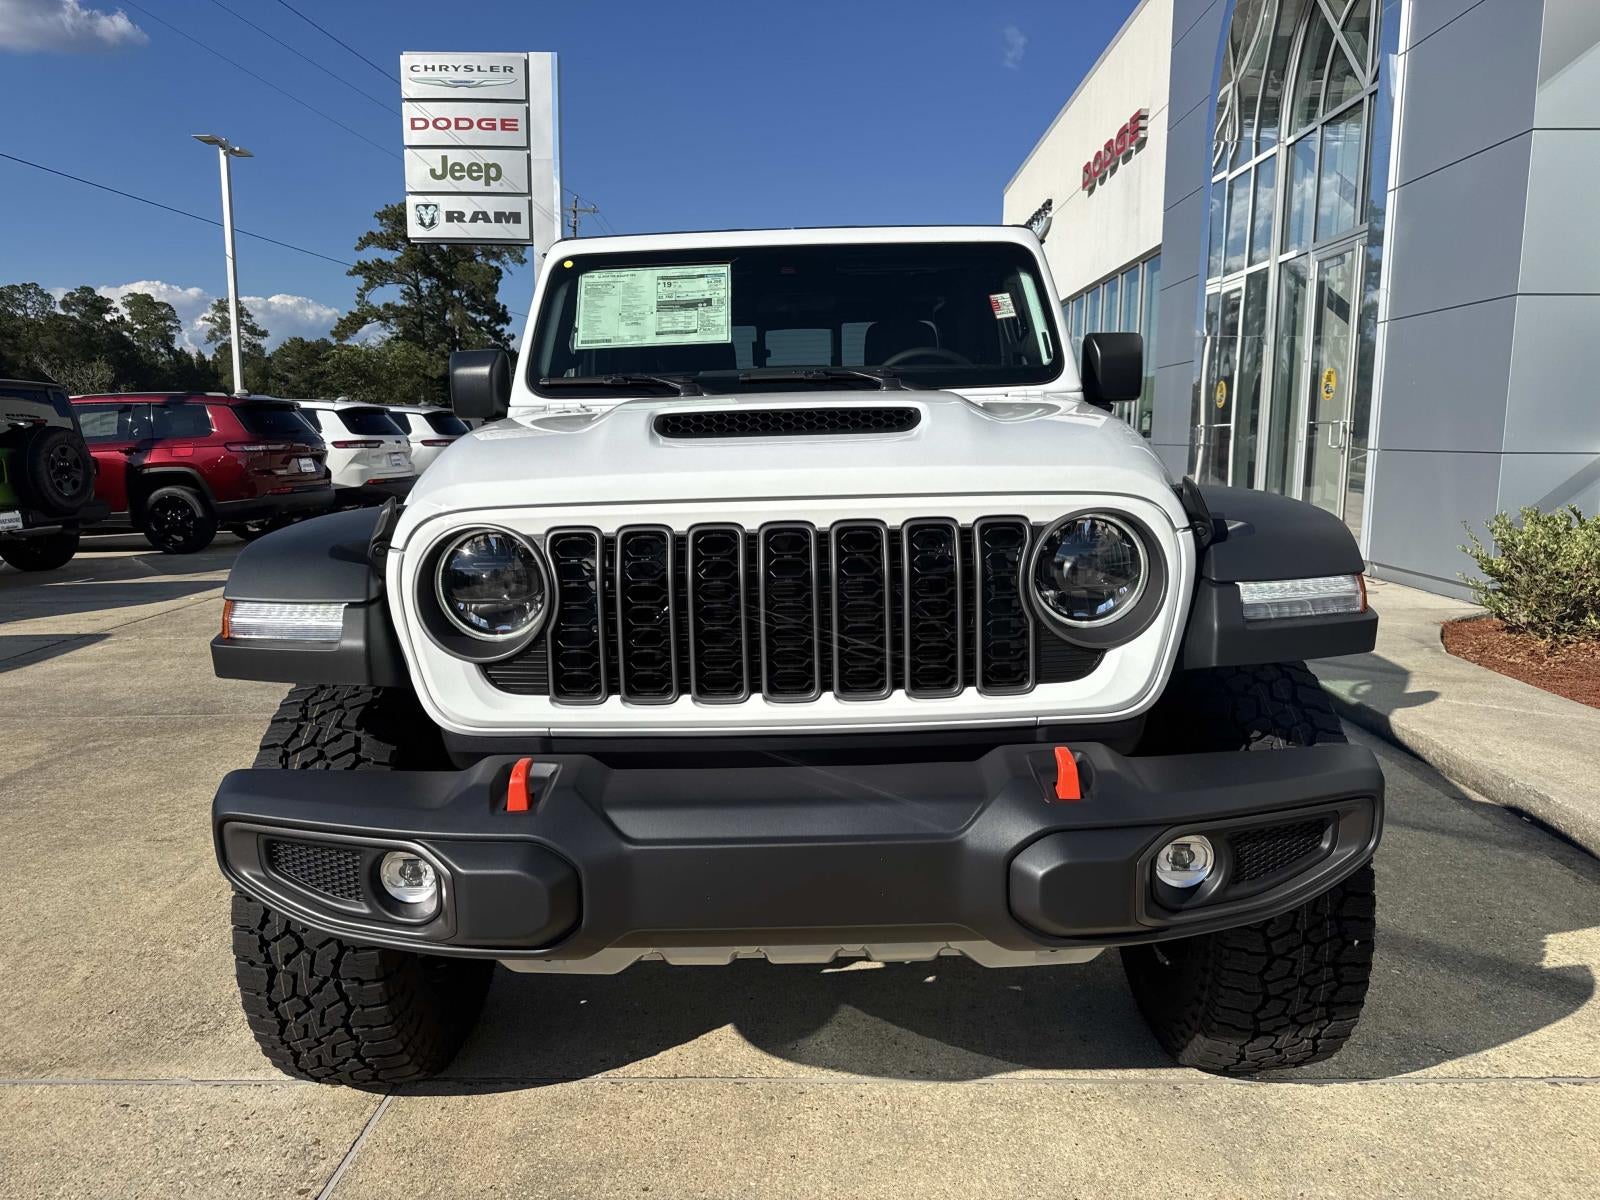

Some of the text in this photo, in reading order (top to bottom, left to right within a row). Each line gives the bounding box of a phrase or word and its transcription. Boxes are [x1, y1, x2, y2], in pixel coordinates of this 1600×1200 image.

[410, 64, 514, 74] CHRYSLER
[410, 117, 519, 131] DODGE
[1082, 108, 1149, 191] DODGE
[429, 155, 503, 187] Jeep
[445, 210, 522, 224] RAM
